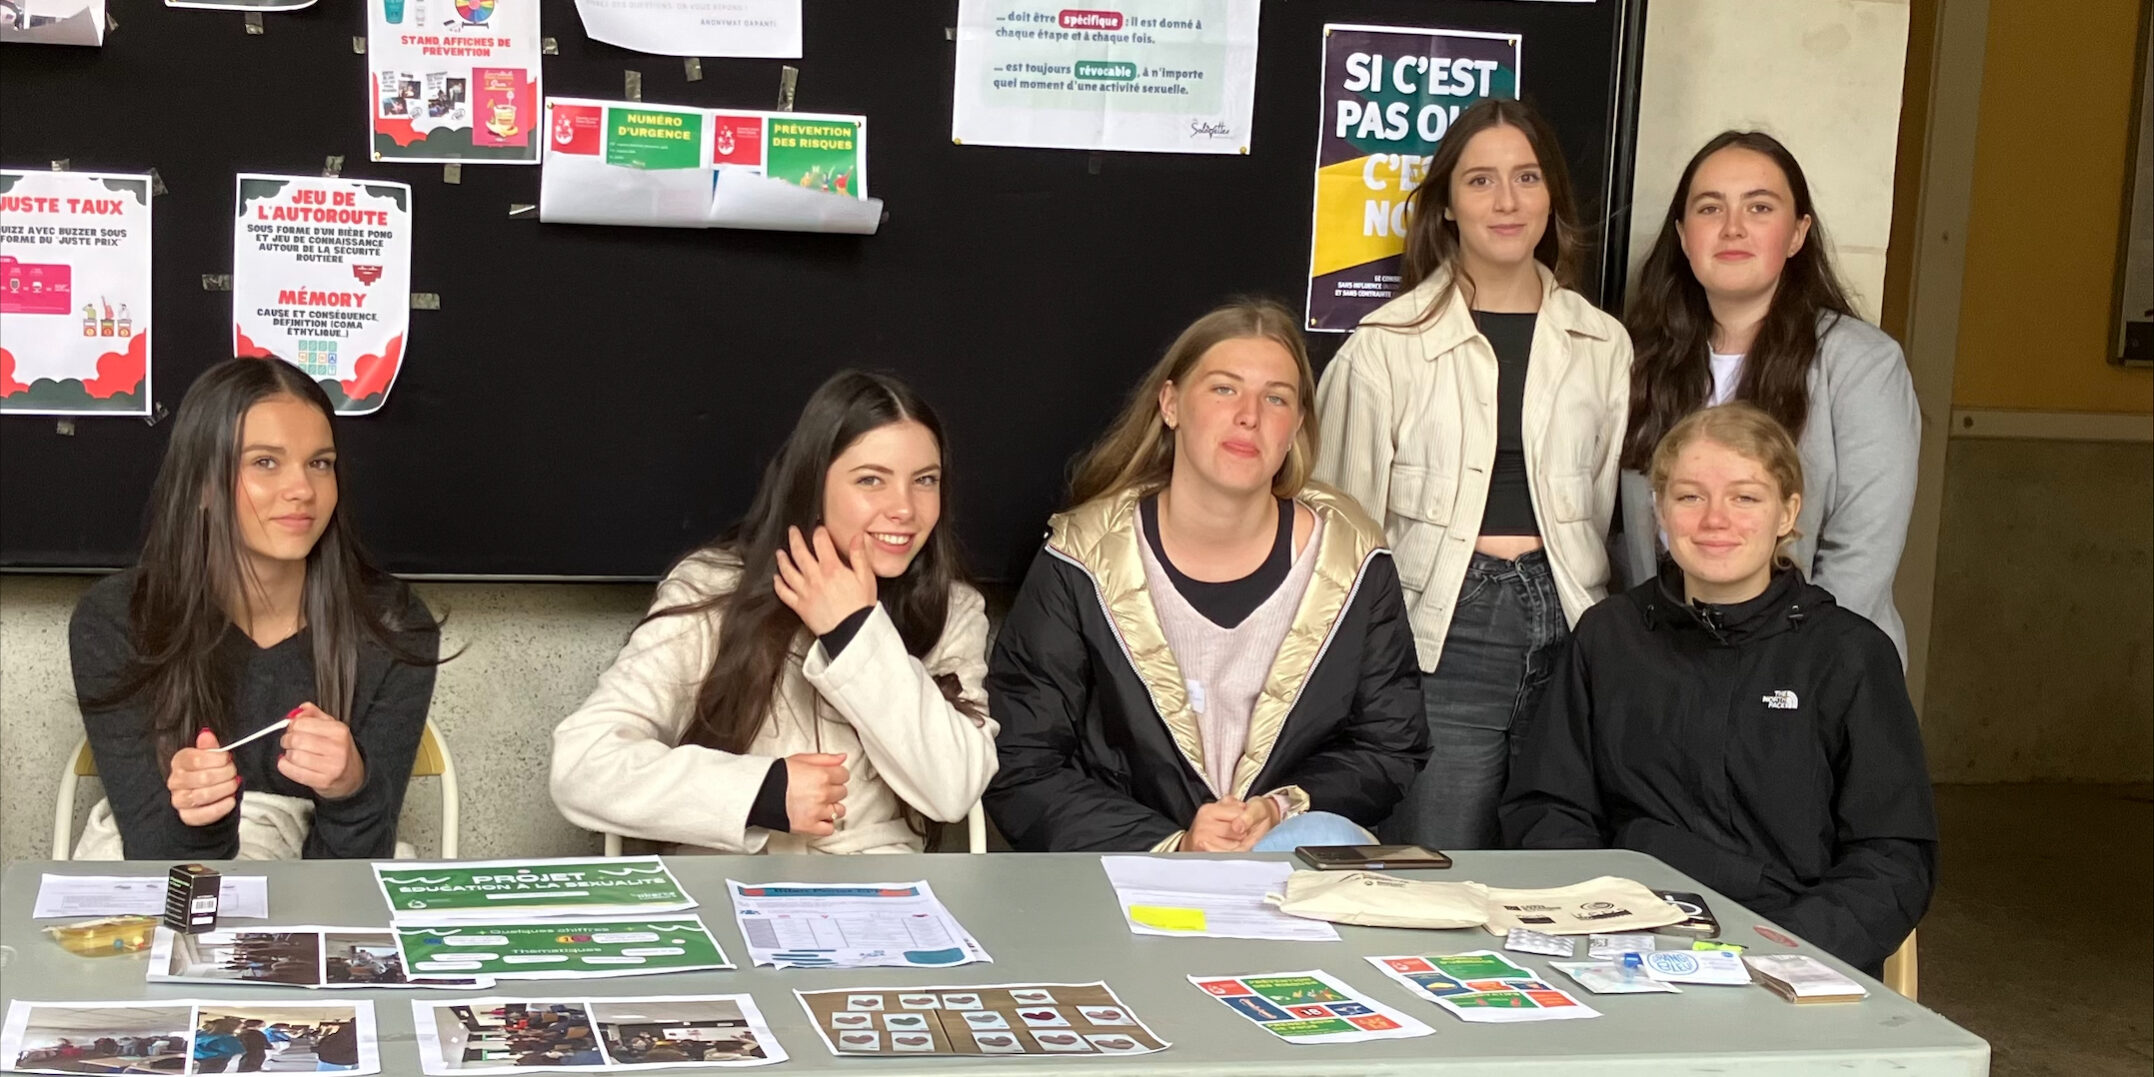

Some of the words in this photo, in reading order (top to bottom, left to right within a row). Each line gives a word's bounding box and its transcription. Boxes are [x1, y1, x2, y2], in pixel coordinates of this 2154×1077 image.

[1008, 11, 1030, 22] doit
[1033, 12, 1056, 23] être
[1063, 14, 1118, 28] spécifique
[1131, 17, 1138, 26] il
[1140, 19, 1157, 27] est
[1159, 18, 1193, 29] donné
[1195, 20, 1202, 29] à
[401, 35, 440, 45] STAND
[443, 37, 495, 47] AFFICHES
[497, 38, 511, 47] DE
[995, 27, 1035, 40] chaque
[1037, 29, 1069, 42] étape
[1071, 31, 1082, 40] et
[1083, 31, 1090, 41] à
[1092, 32, 1130, 44] chaque
[1132, 32, 1156, 44] fois.
[1005, 63, 1023, 72] est
[1025, 63, 1071, 75] toujours
[1079, 65, 1132, 77] révocable
[1142, 67, 1149, 77] à
[1343, 52, 1383, 93] SI
[993, 78, 1017, 90] quel
[1019, 80, 1064, 90] moment
[1066, 81, 1098, 91] d'une
[1099, 82, 1140, 93] activité
[1142, 84, 1189, 95] sexuelle.
[627, 113, 683, 126] NUMÉRO
[1336, 100, 1409, 140] PAS
[773, 124, 852, 137] PRÉVENTION
[772, 138, 796, 147] DES
[799, 139, 853, 150] RISQUES
[0, 196, 60, 213] JUSTE
[66, 198, 124, 215] TAUX
[291, 190, 327, 205] JEU
[332, 192, 356, 207] DE
[257, 205, 388, 226] L'AUTOROUTE
[28, 227, 55, 235] AVEC
[58, 227, 97, 236] BUZZER
[100, 229, 127, 237] SOUS
[247, 224, 273, 233] SOUS
[276, 225, 311, 235] FORME
[338, 226, 365, 238] BIÈRE
[368, 230, 393, 239] PONG
[0, 235, 36, 244] FORME
[39, 236, 53, 244] DU
[255, 234, 269, 242] ET
[272, 235, 290, 243] JEU
[294, 236, 305, 244] DE
[308, 236, 384, 248] CONNAISSANCE
[258, 243, 299, 253] AUTOUR
[302, 245, 314, 253] DE
[317, 246, 330, 254] LA
[278, 286, 367, 308] MÉMORY
[257, 308, 289, 318] CAUSE
[293, 310, 306, 318] ET
[399, 884, 511, 893] ÉDUCATION
[565, 877, 666, 888] SEXUALITÉ
[472, 872, 586, 884] PROJET
[1302, 1007, 1322, 1016] 18
